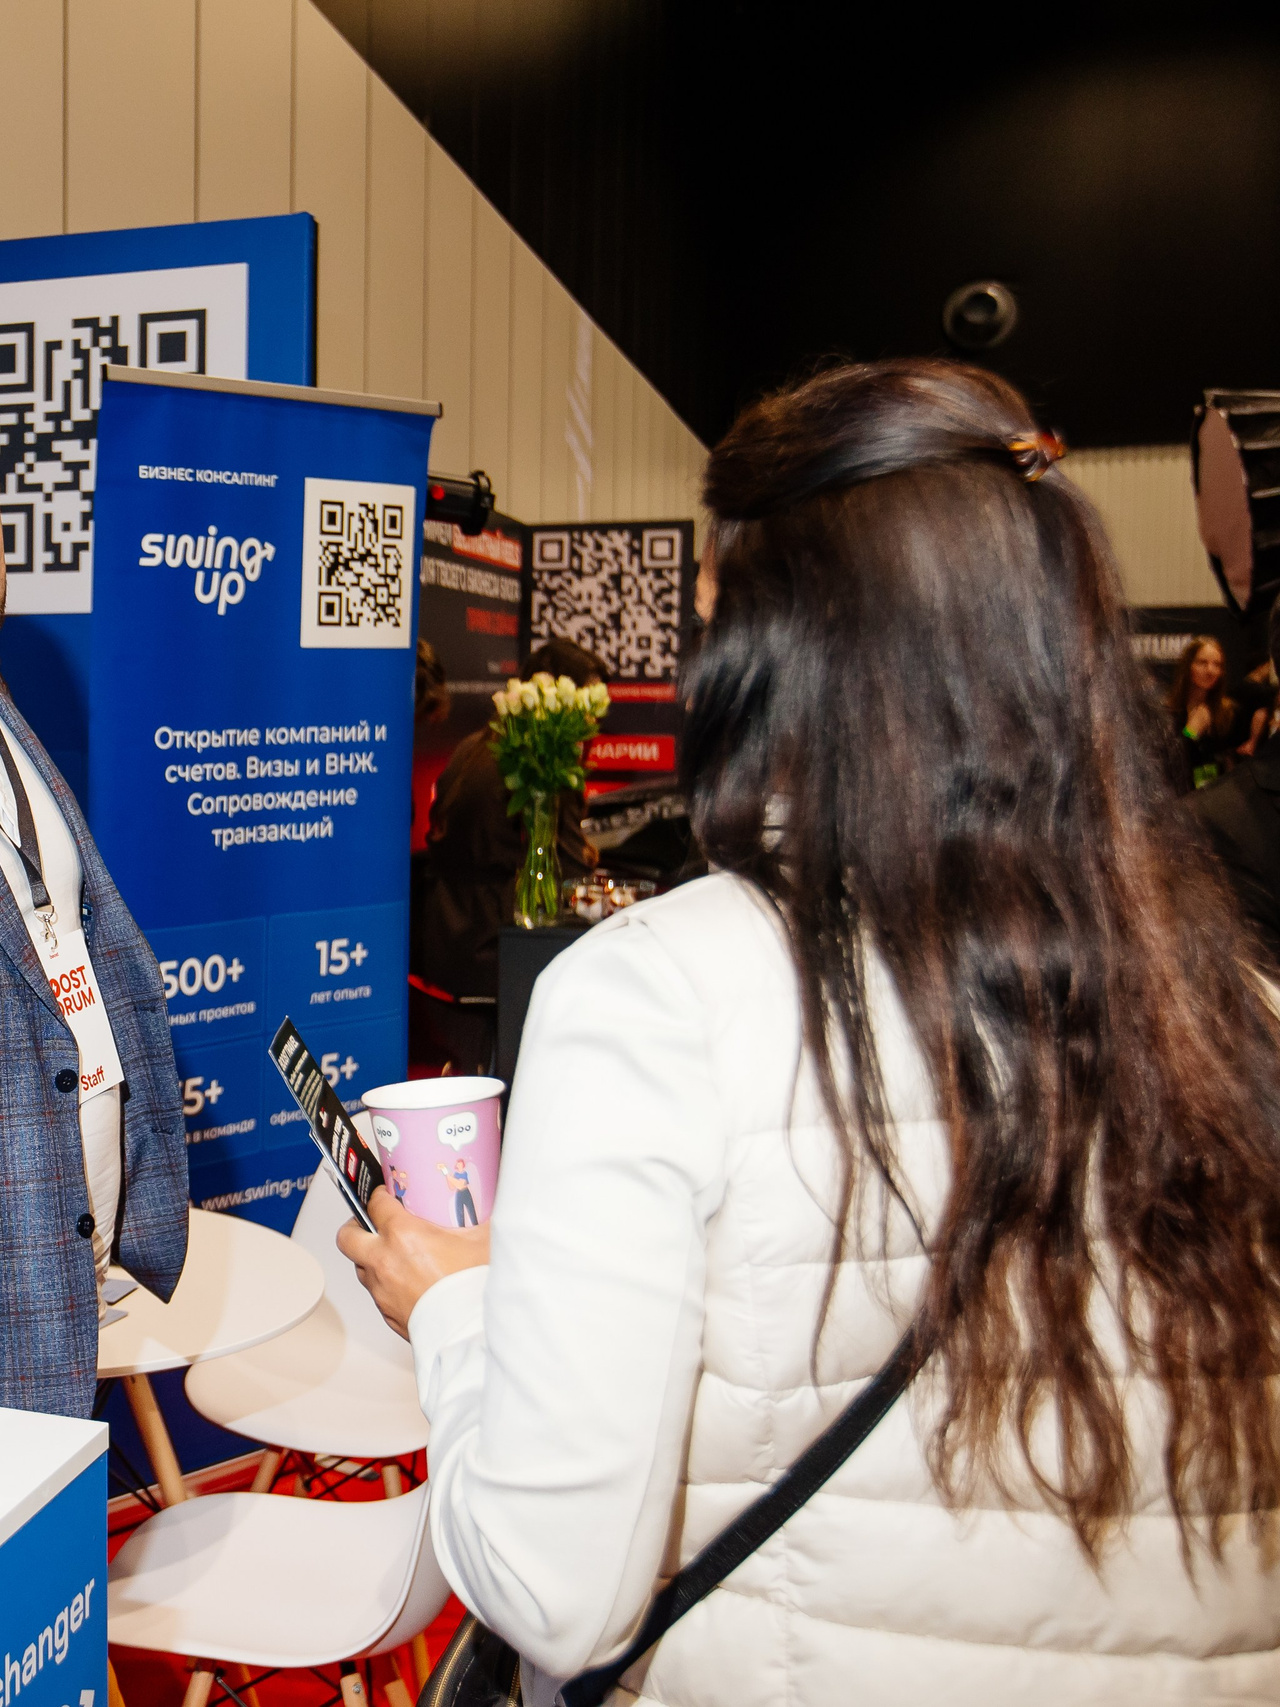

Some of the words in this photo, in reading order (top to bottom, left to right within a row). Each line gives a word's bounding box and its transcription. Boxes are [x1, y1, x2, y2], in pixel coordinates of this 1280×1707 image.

[138, 465, 195, 482] БИЗНЕС
[196, 469, 279, 488] КОНСАЛТИНГ
[138, 525, 276, 582] swing
[194, 570, 246, 616] up
[154, 726, 260, 753] Открытие
[265, 719, 370, 745] компаний
[375, 724, 387, 742] и
[165, 762, 242, 783] счетов.
[246, 756, 300, 779] Визы
[306, 758, 319, 775] и
[325, 751, 378, 776] ВНЖ.
[187, 787, 358, 818] Сопровождение
[211, 815, 334, 851] транзакций
[315, 938, 368, 977] 15+
[160, 954, 245, 999] 500+
[310, 990, 332, 1005] лет
[333, 985, 372, 1002] опыта
[199, 1001, 257, 1023] проектов
[80, 1065, 106, 1091] Staff
[178, 1076, 224, 1116] 5+
[204, 1118, 256, 1140] команде
[446, 1124, 471, 1136] ojoo
